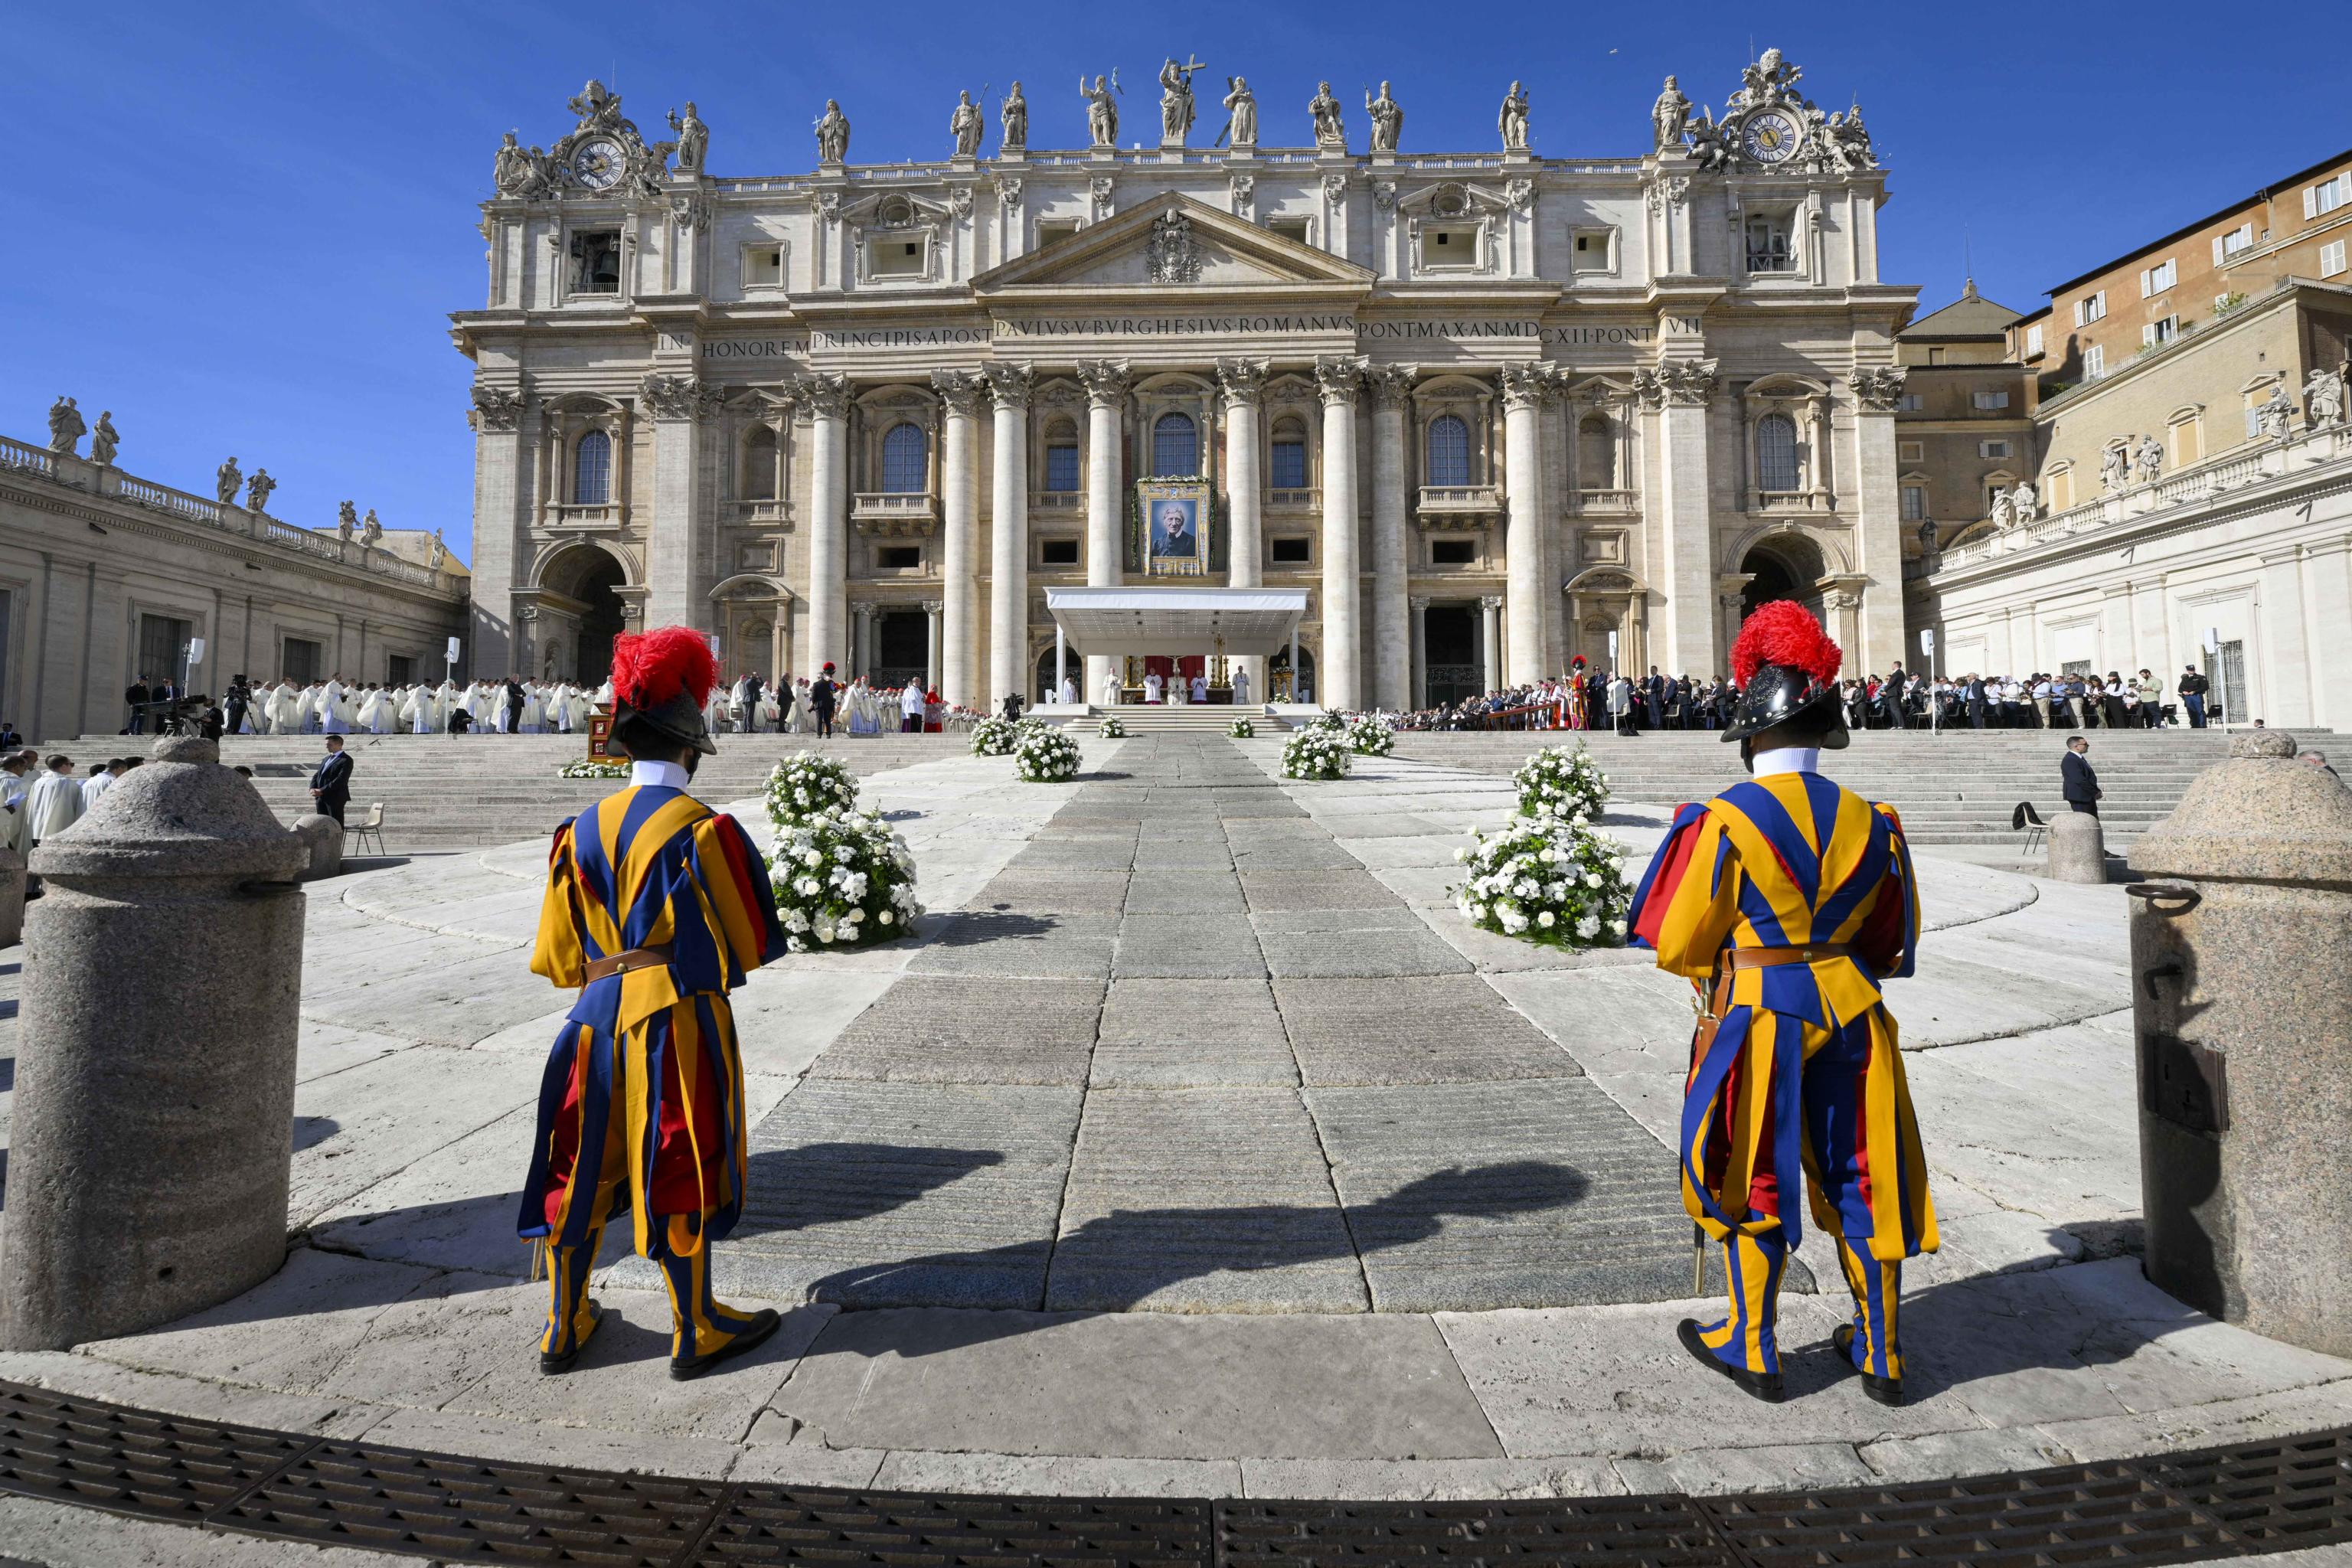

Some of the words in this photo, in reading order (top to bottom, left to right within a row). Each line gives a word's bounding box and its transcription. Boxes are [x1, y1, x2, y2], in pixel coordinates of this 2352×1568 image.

[660, 335, 684, 351] IN
[702, 341, 810, 358] HONOREM
[813, 330, 922, 348] PRINCIPIS
[927, 328, 994, 345] APOST
[995, 320, 1069, 337] PAVLVS
[1093, 318, 1231, 336] BVRGHESIVS
[1238, 315, 1354, 334] ROMANVS
[1357, 322, 1416, 338] PONT
[1417, 322, 1465, 338] MAX
[1469, 322, 1499, 338] AN
[1595, 327, 1654, 344] PONT
[1668, 318, 1700, 334] VII
